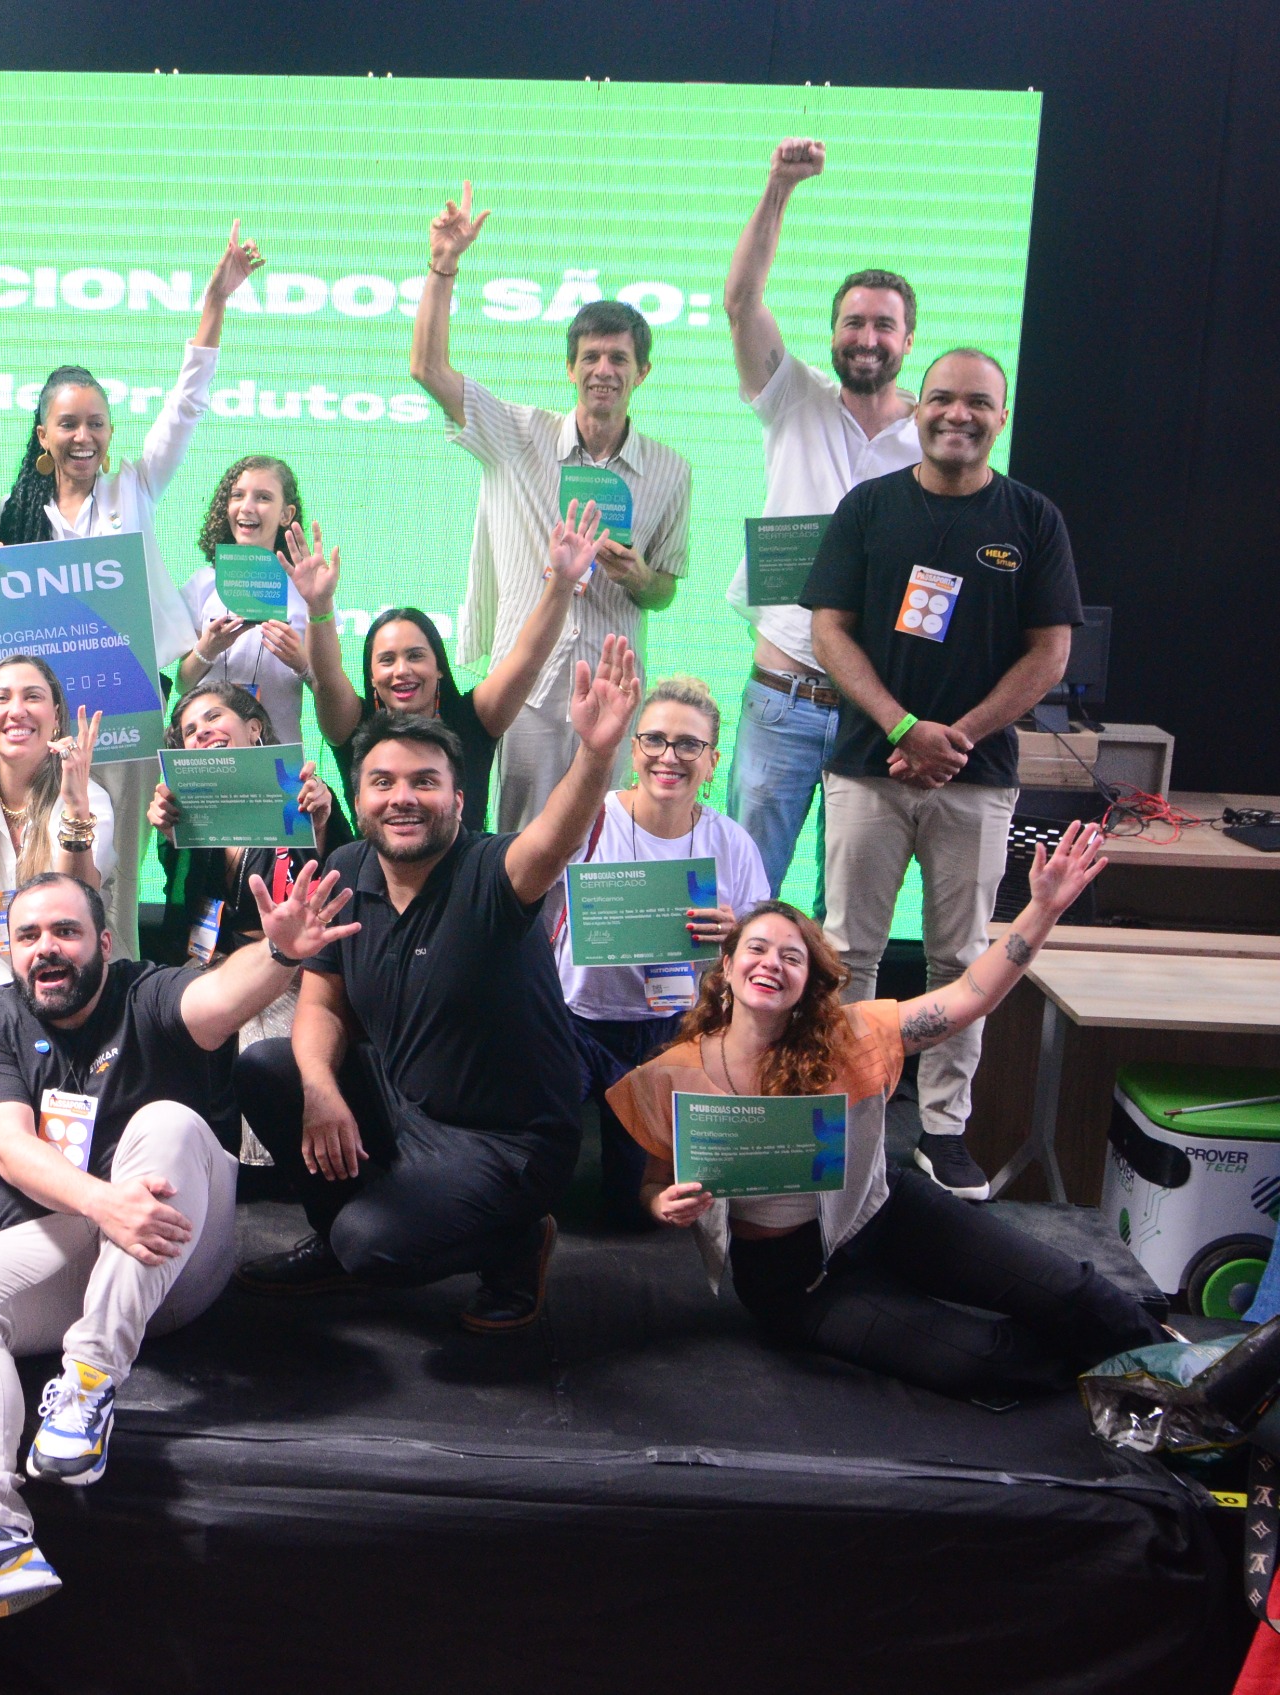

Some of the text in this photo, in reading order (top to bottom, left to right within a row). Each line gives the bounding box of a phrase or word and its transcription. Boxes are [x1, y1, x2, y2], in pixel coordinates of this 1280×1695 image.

[482, 269, 711, 326] SÃO:
[96, 378, 429, 422] Prdutos
[985, 549, 1008, 559] HELP
[223, 580, 282, 589] IMPACTO PREMIADO
[265, 590, 281, 599] 2025
[70, 622, 99, 637] NIIS
[63, 641, 76, 653] DO
[78, 638, 99, 651] HUB
[100, 633, 131, 648] GOIÁS
[215, 757, 236, 765] NIIS
[174, 766, 237, 775] CERTIFICADO
[624, 870, 646, 879] NIIS
[580, 879, 647, 889] CERTIFICADO
[741, 1106, 766, 1114] NIIS
[689, 1114, 766, 1124] CERTIFICADO
[690, 1129, 739, 1138] Certificamos
[1185, 1147, 1248, 1165] PROVER
[1206, 1162, 1247, 1174] TECH
